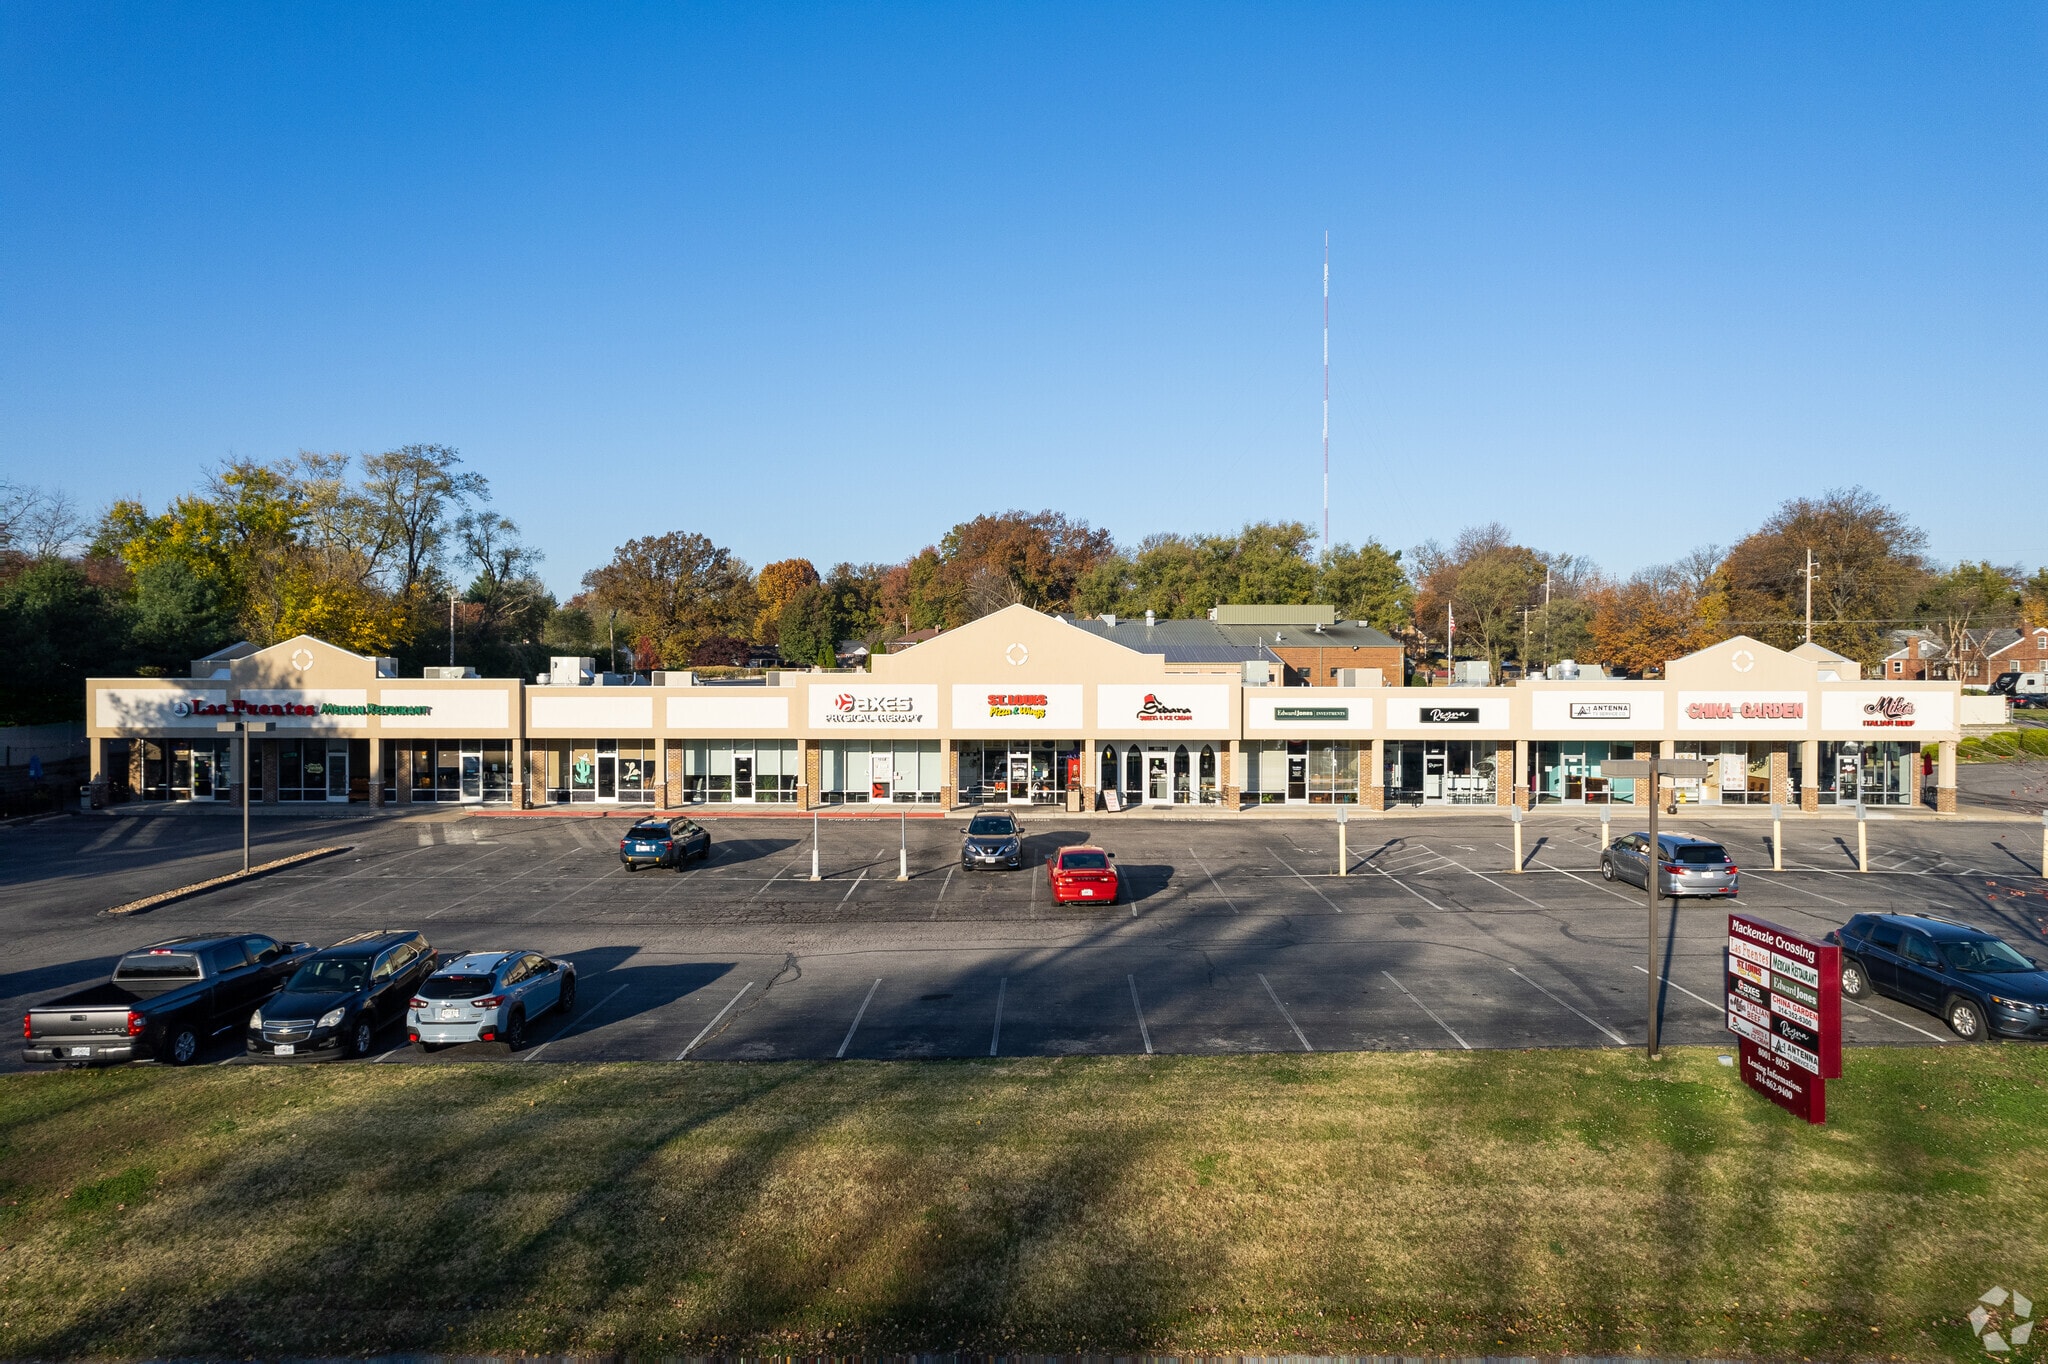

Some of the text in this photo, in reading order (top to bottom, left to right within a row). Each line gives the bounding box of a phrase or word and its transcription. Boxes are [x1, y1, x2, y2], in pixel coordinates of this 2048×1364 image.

[191, 699, 228, 716] Las
[231, 699, 315, 717] Fuentes
[826, 714, 923, 723] PHYSICAL THERAPY
[990, 706, 1046, 719] Pizza & Wings
[1687, 702, 1804, 720] CHINA GARDEN
[1732, 919, 1816, 964] Mackenzie Crossing
[1743, 943, 1769, 966] Fuentes
[1746, 1002, 1769, 1019] ITALIAN
[1747, 1010, 1761, 1023] BEEF
[1772, 995, 1819, 1021] CHINA GARDEN
[1778, 1005, 1812, 1027] 314-352-8300
[1757, 1047, 1771, 1061] 8001
[1775, 1056, 1790, 1071] 8025
[1788, 1045, 1818, 1066] ANTENNA
[1793, 1054, 1809, 1069] SERVICE
[1748, 1055, 1803, 1093] Leasing Information:
[1755, 1072, 1793, 1100] 314-862-9400
